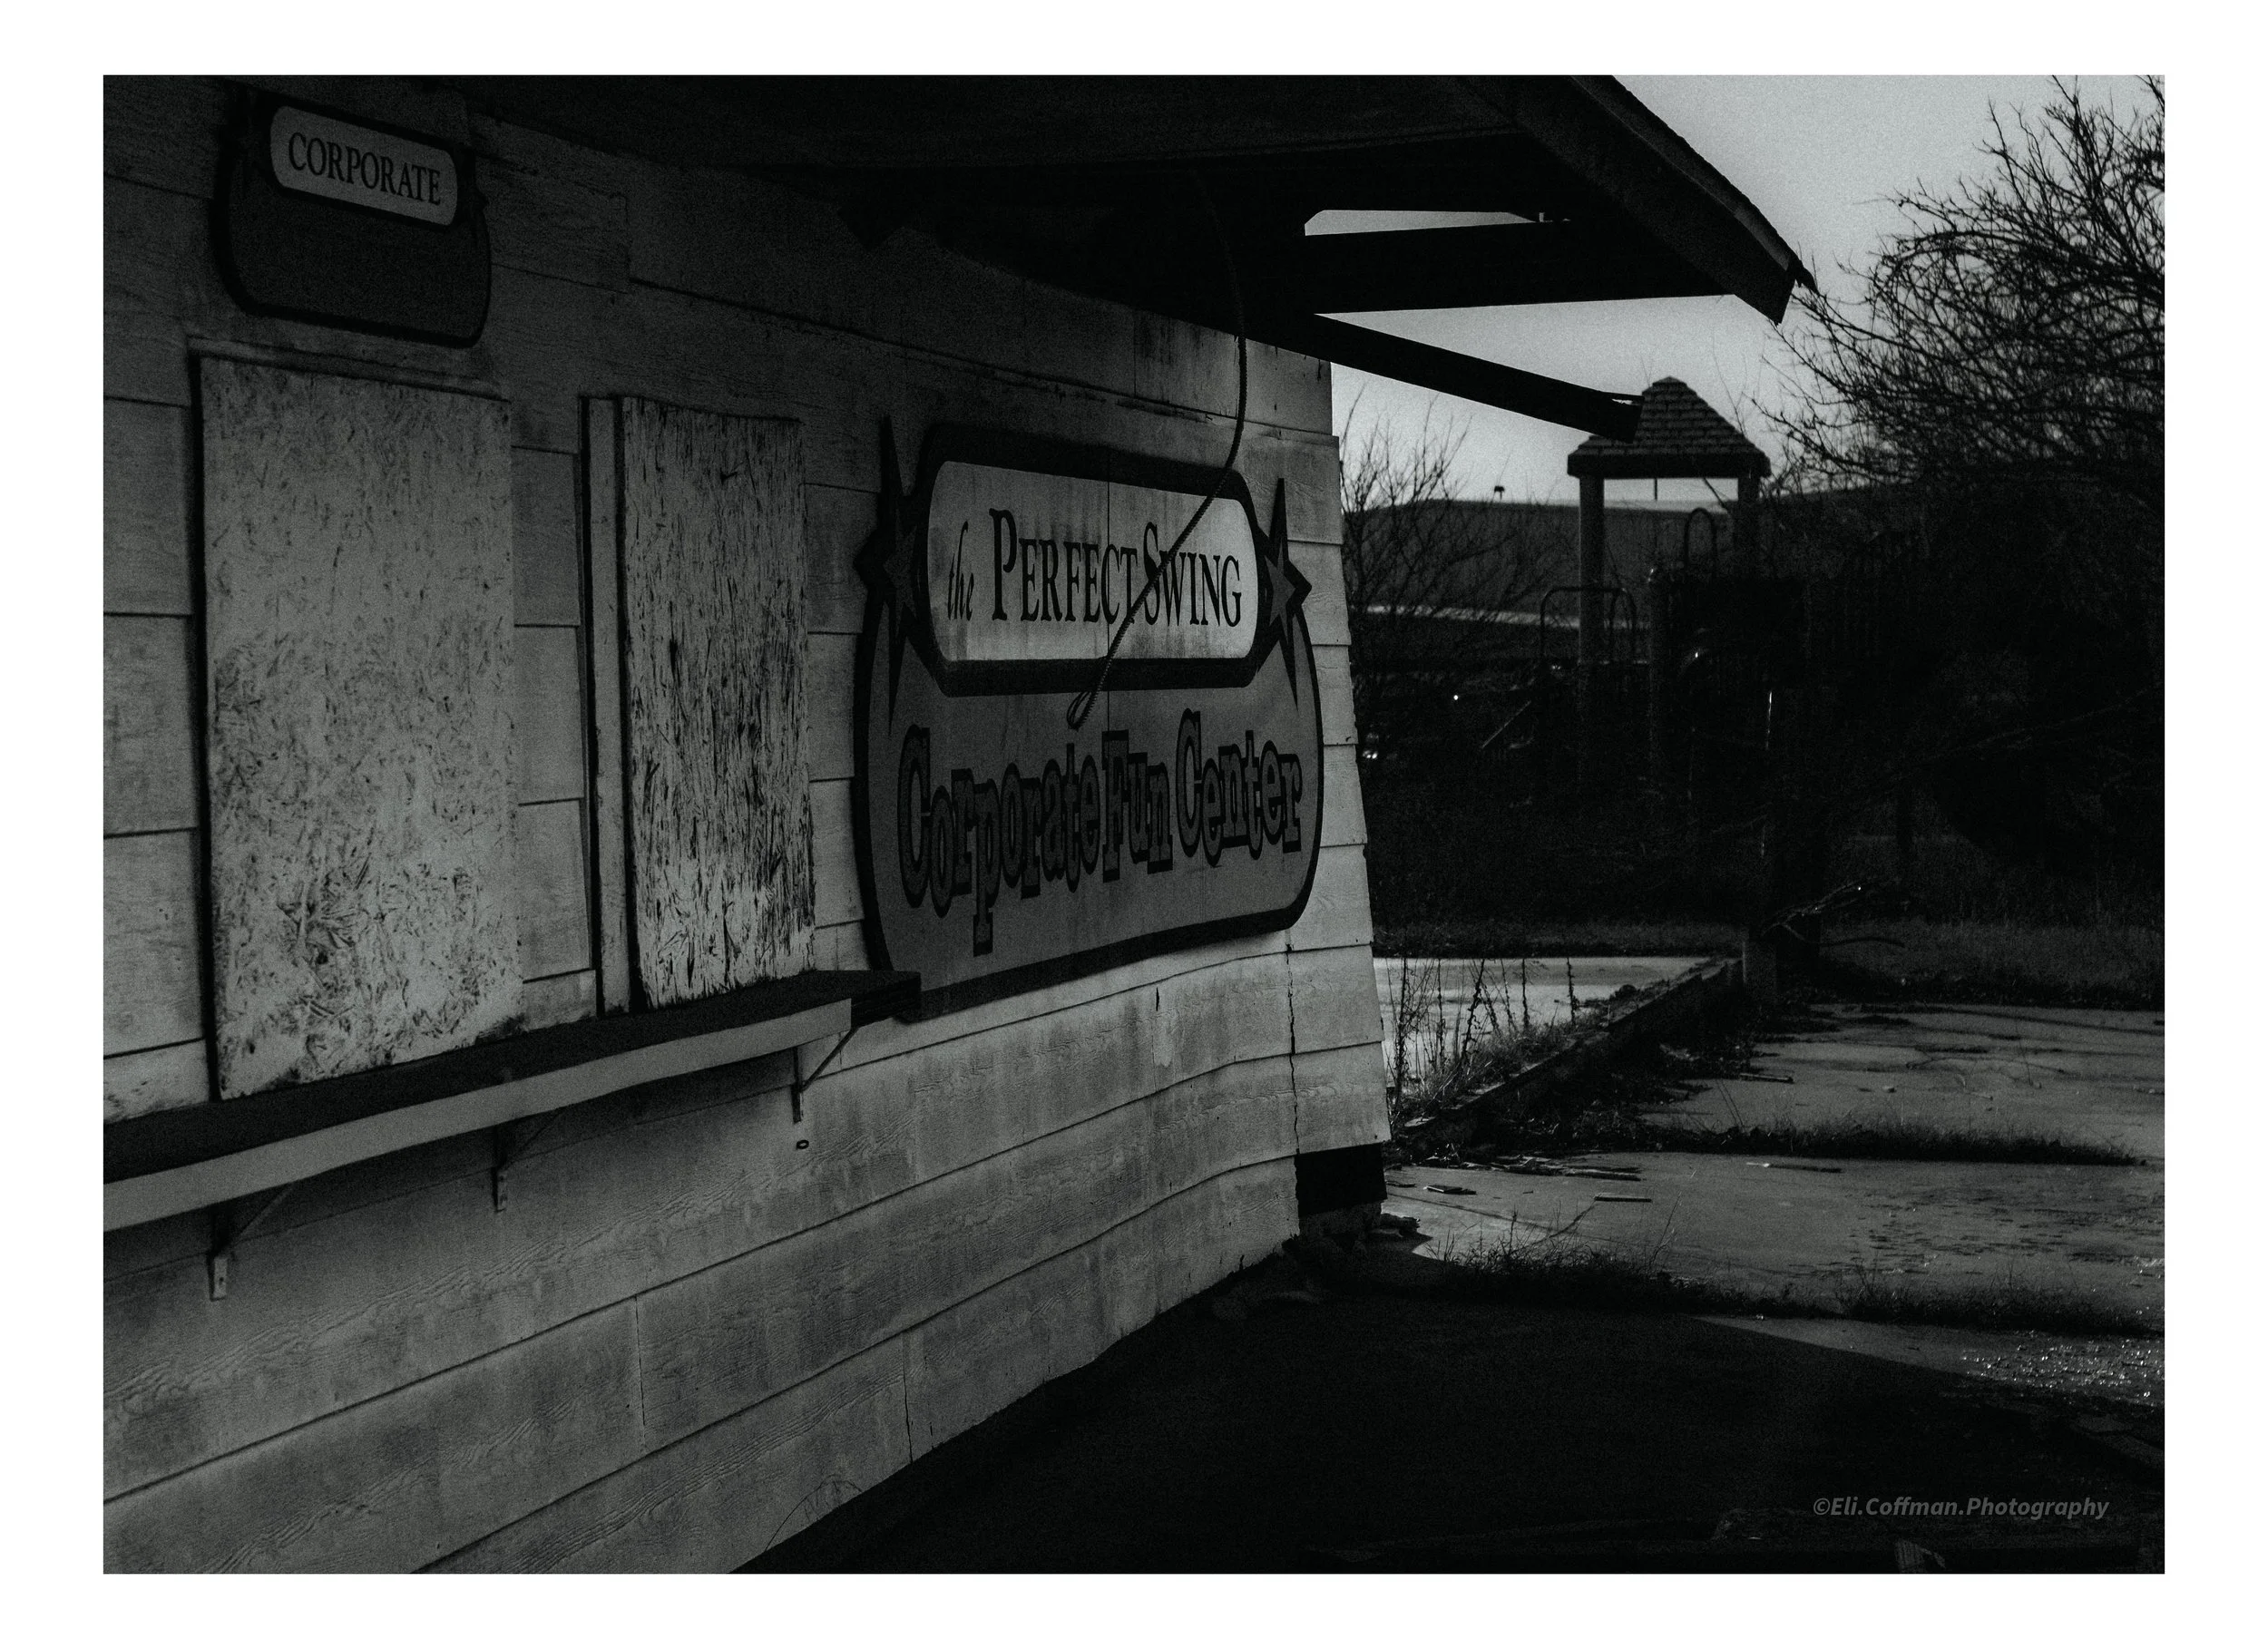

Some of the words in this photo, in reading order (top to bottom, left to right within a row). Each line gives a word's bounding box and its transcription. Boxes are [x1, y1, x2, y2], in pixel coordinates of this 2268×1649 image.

[288, 132, 441, 206] CORPORATE
[947, 521, 974, 620] the
[989, 508, 1138, 625] PERFECT
[1143, 522, 1242, 627] SWING
[898, 725, 1100, 957] Corporate
[1102, 729, 1173, 883] Fun
[1177, 708, 1303, 866] Center
